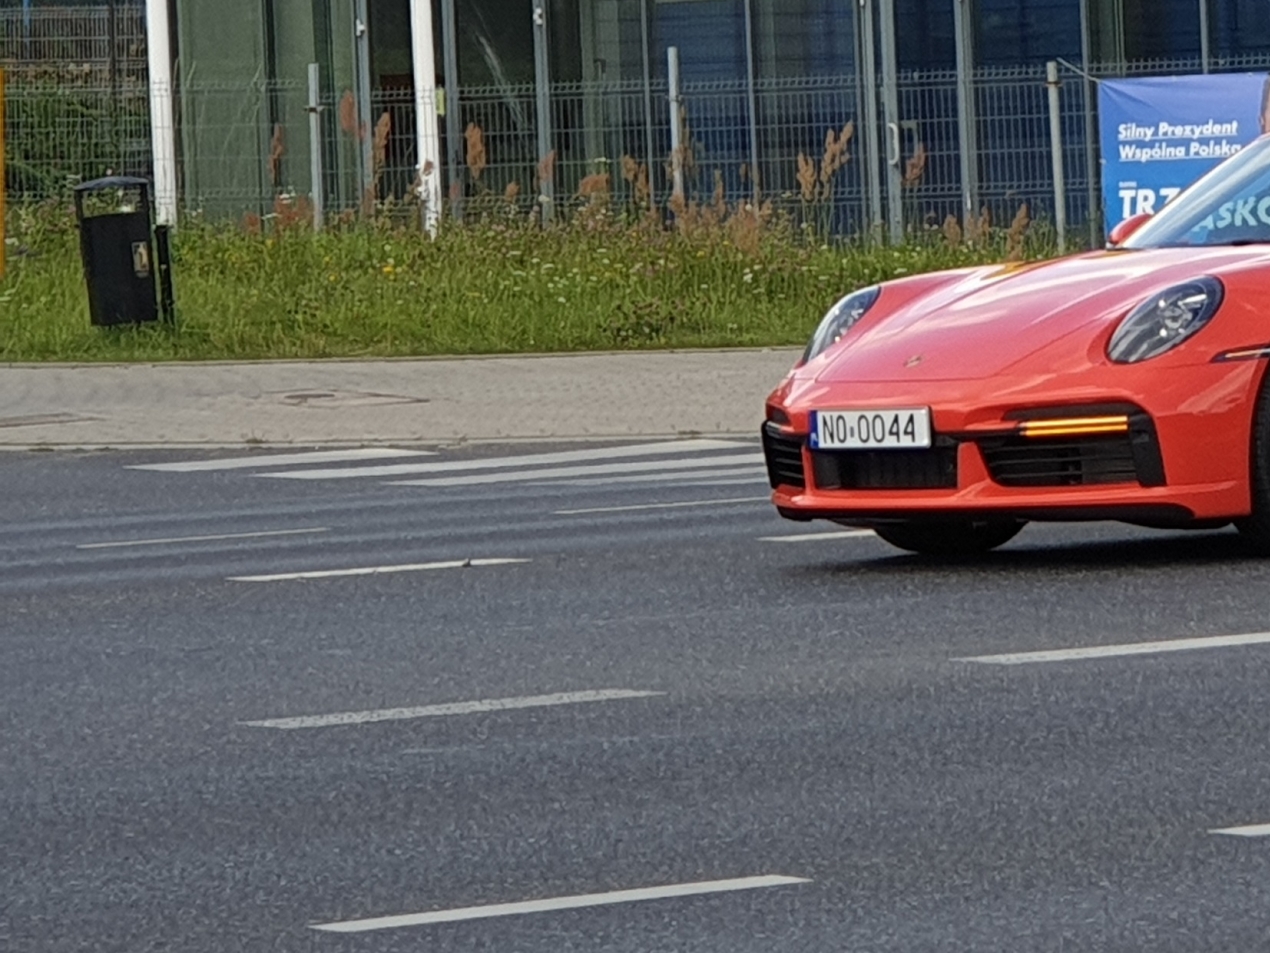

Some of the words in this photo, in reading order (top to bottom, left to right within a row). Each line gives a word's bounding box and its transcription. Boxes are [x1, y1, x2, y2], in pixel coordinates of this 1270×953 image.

[1118, 123, 1155, 141] Silny
[1159, 119, 1238, 139] Prezydent
[1118, 142, 1186, 163] Wspólna
